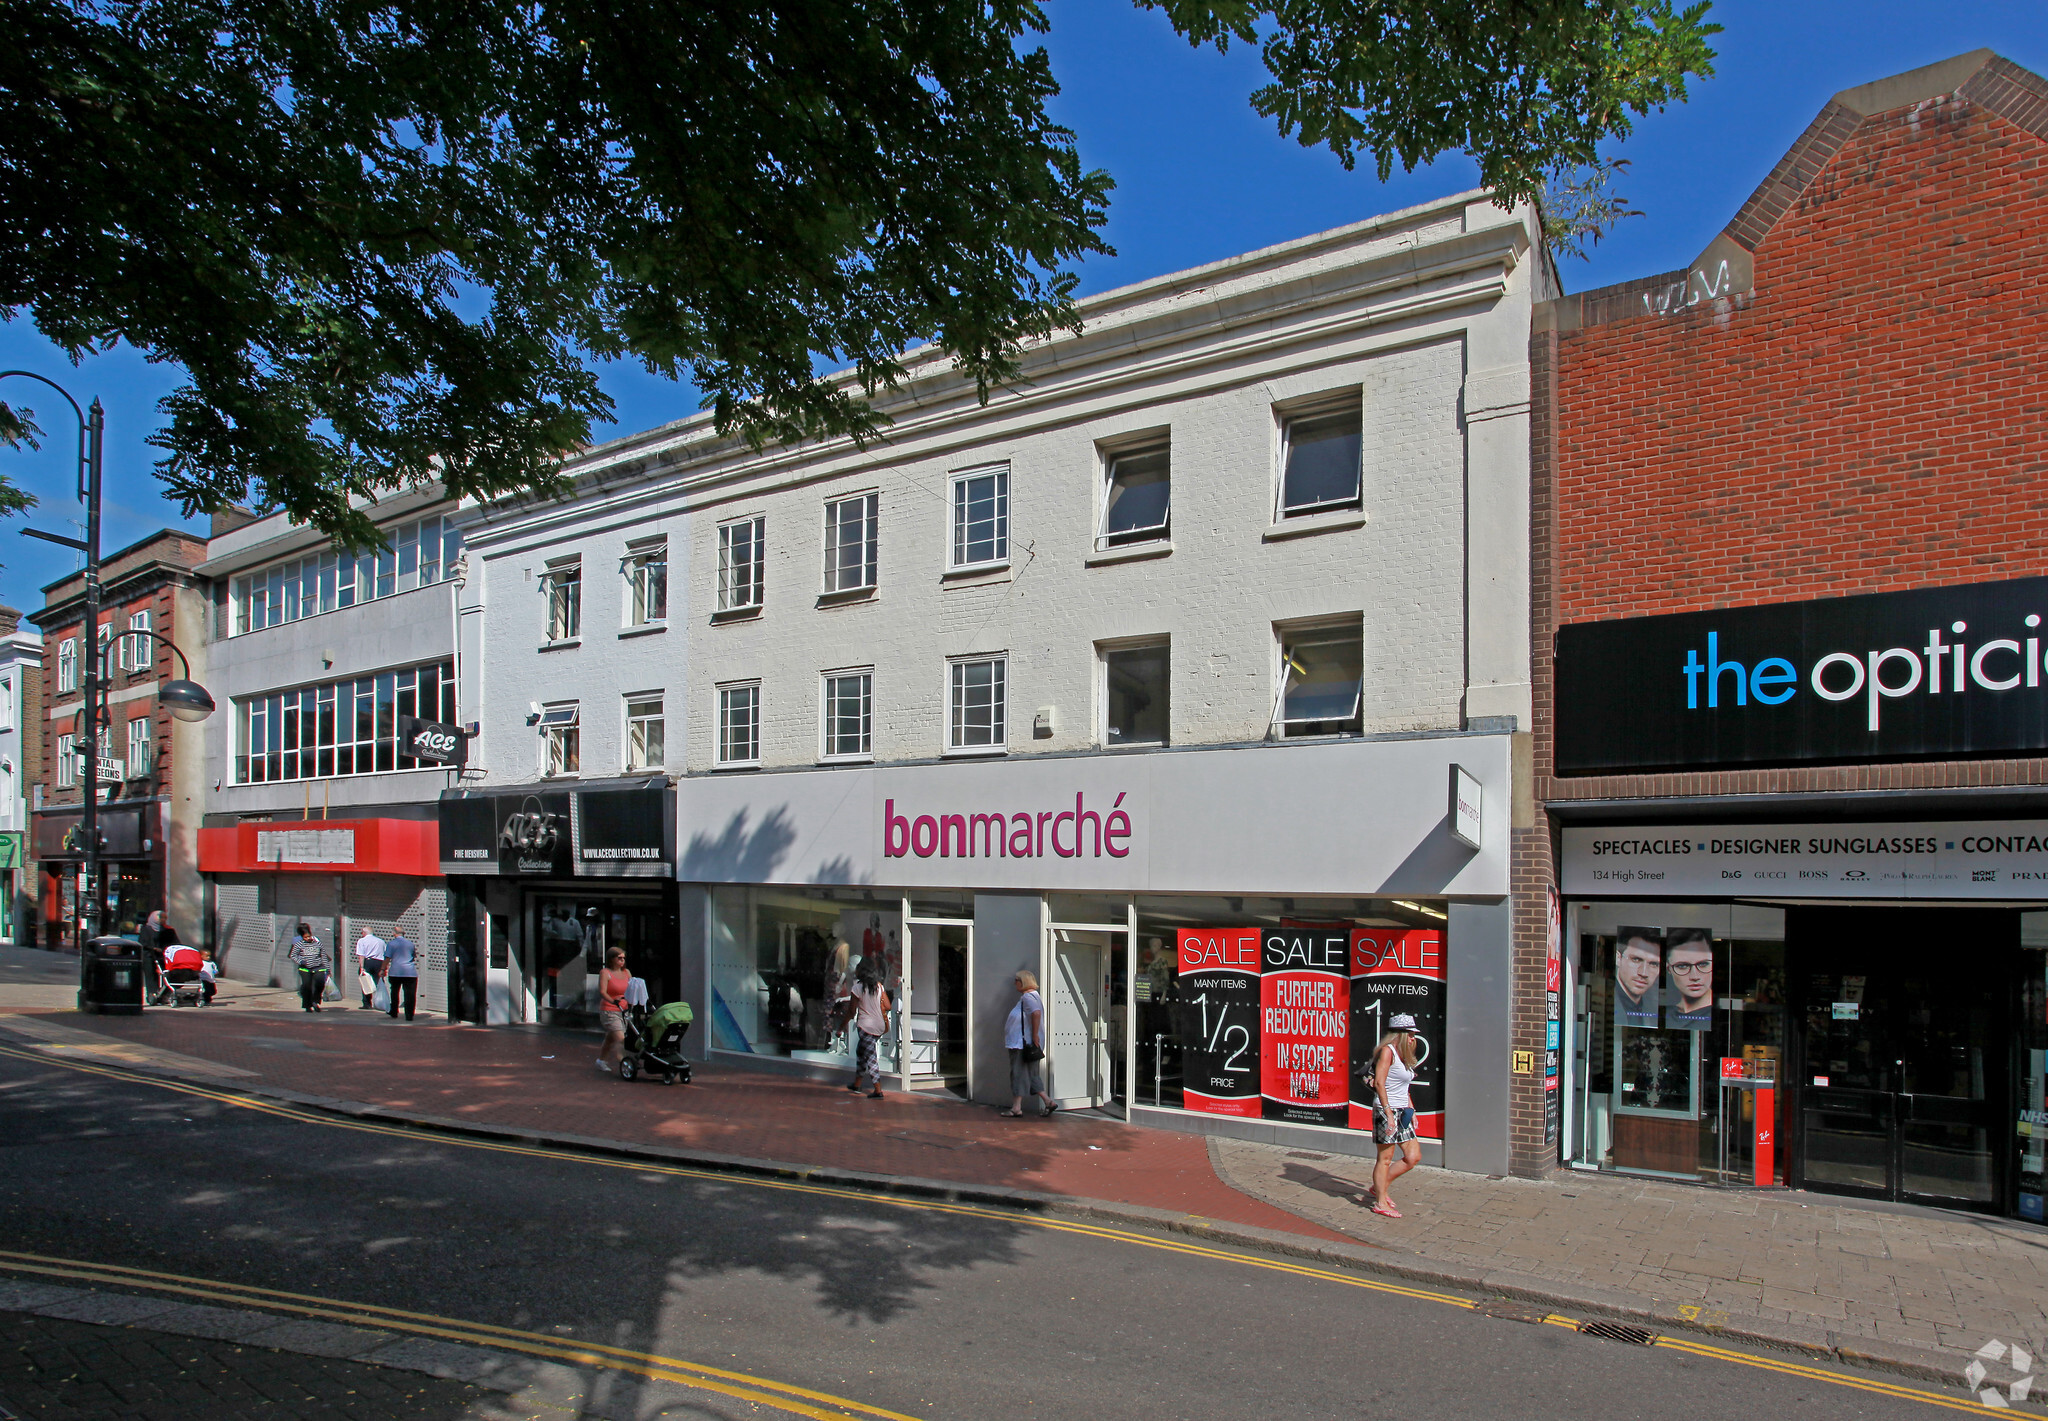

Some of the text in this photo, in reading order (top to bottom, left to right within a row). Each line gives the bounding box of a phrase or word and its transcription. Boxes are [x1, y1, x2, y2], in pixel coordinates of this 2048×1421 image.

[1683, 614, 2048, 732] the optici
[414, 731, 456, 751] ACE
[80, 765, 120, 779] SGEONS
[884, 791, 1132, 858] bonmarché
[454, 850, 488, 858] FINE MENSWEAR
[583, 848, 660, 858] WWW.ACECOLLECTION.CO.UK
[1592, 836, 2048, 855] SPECTACLES DESIGNER SUNGLASSES CONTA
[518, 857, 552, 869] Collection
[1592, 869, 1665, 883] 134 High Street
[1721, 870, 1742, 879] D&G
[1754, 871, 1787, 879] GUCCI
[1799, 870, 1828, 879] BOSS
[1184, 936, 1256, 965] SALE
[1266, 936, 1344, 967] SALE
[1356, 938, 1441, 969] SALE
[1194, 978, 1247, 989] MANY ITEMS
[1367, 983, 1429, 996] MANY ITEMS
[1276, 980, 1335, 1009] FURTHER
[1265, 1007, 1346, 1039] REDUCTIONS
[1192, 992, 1250, 1072] 1/2
[1277, 1042, 1334, 1073] IN STORE
[1210, 1077, 1235, 1088] PRICE
[1290, 1072, 1320, 1099] NOW
[2019, 1109, 2048, 1124] NHS
